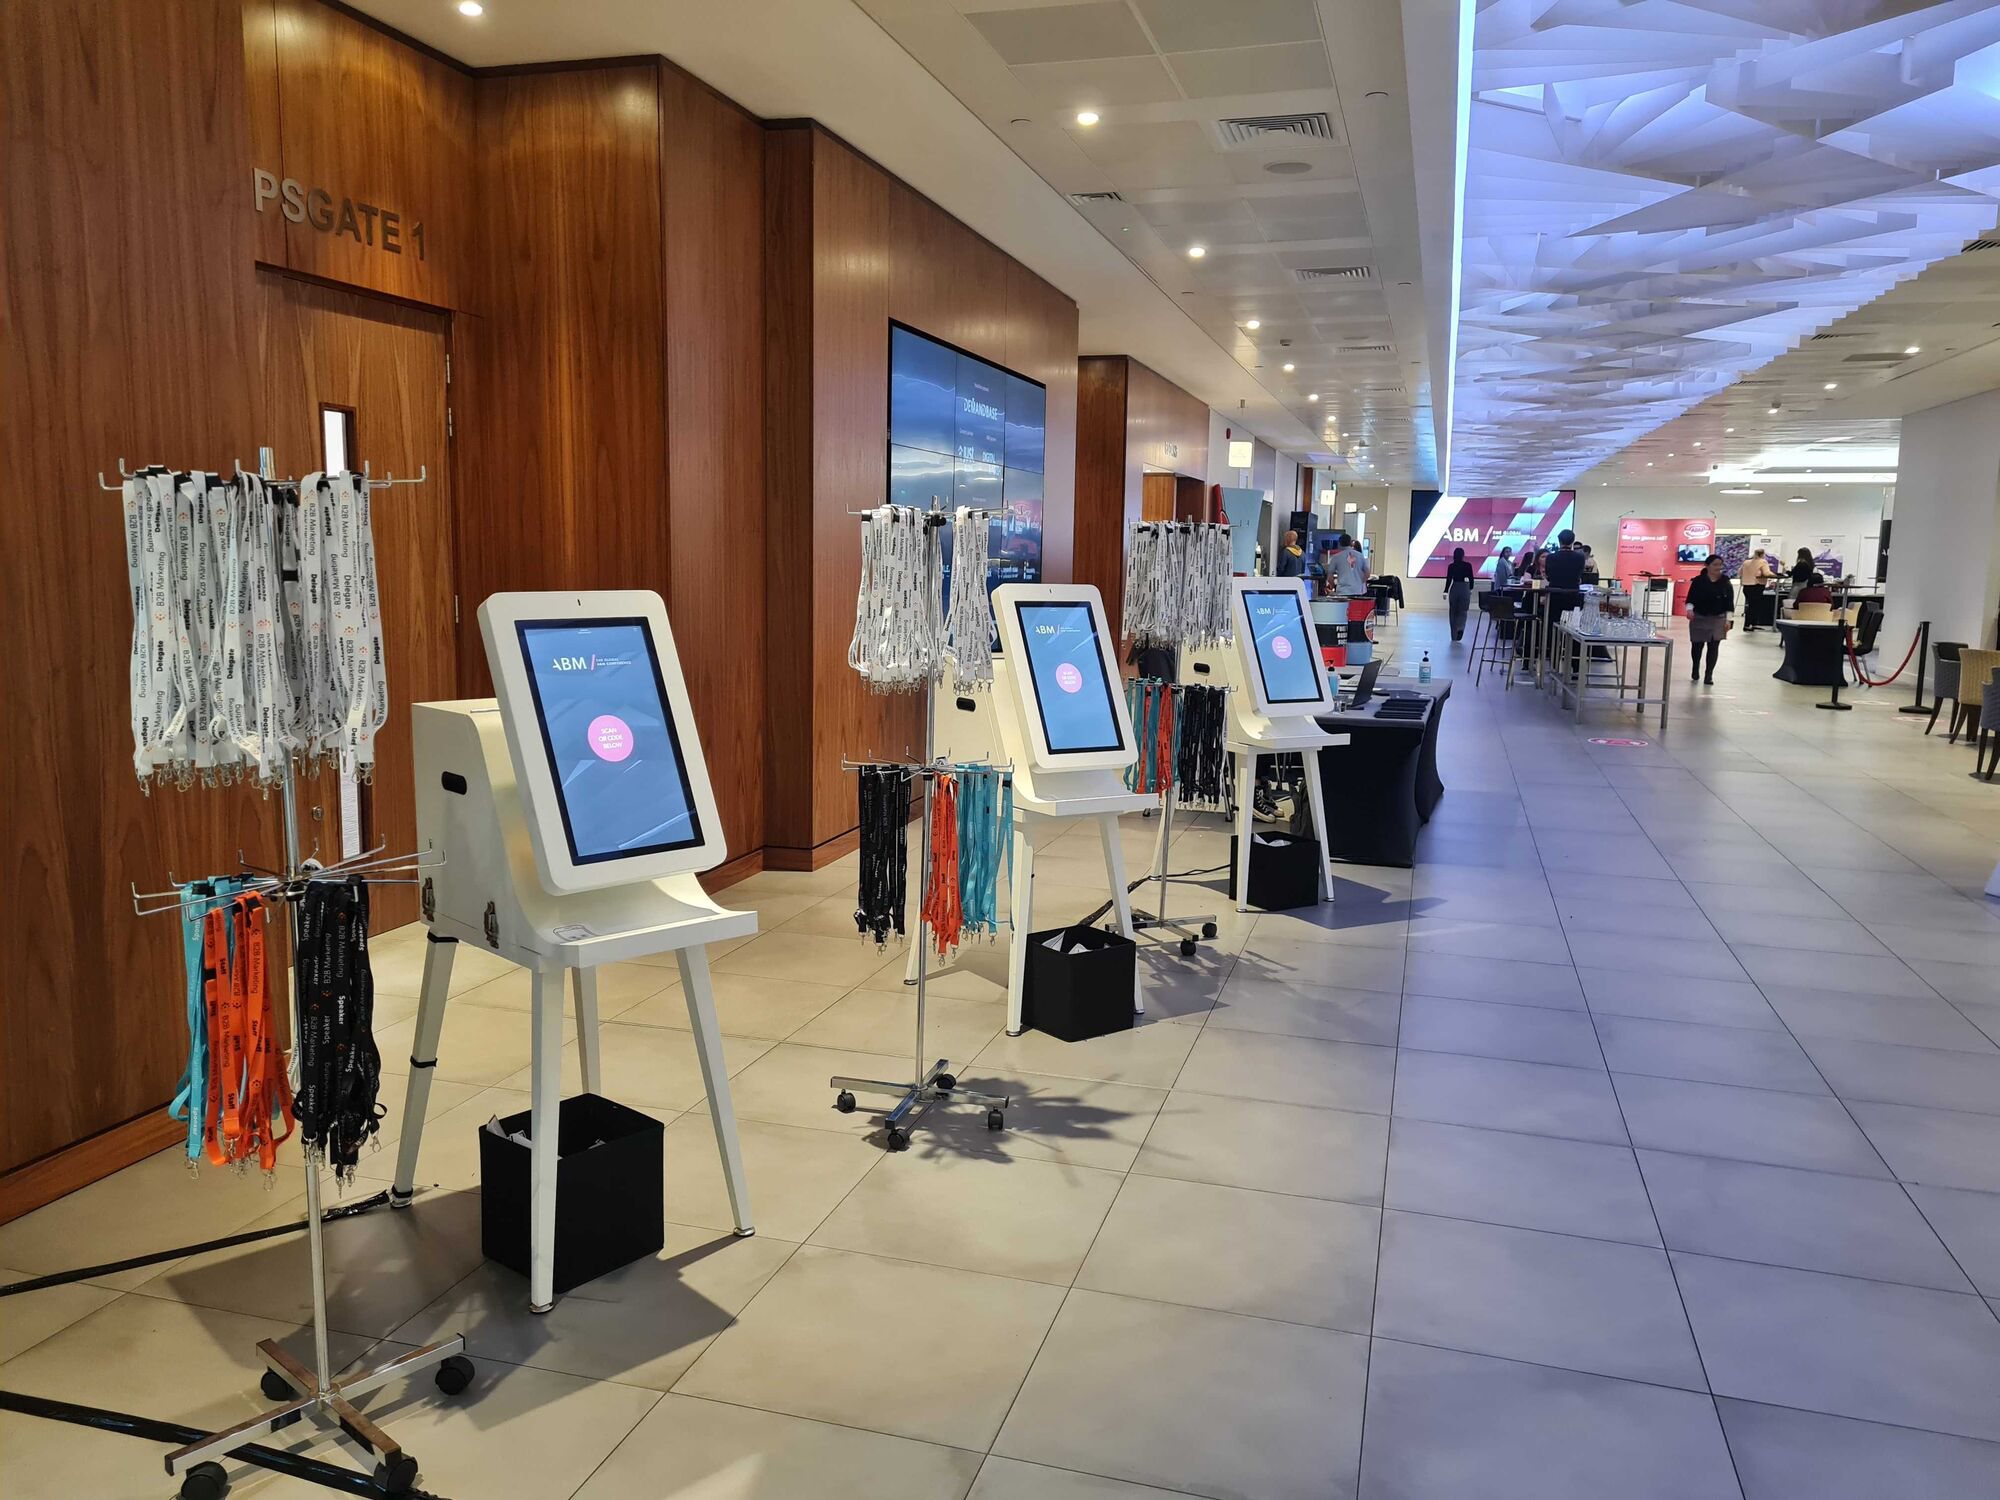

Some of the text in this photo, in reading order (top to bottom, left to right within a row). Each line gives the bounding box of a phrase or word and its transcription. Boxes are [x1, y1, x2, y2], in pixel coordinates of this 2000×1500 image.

[410, 221, 425, 261] 1
[308, 519, 316, 556] Marketing
[324, 506, 332, 536] Delegate
[340, 504, 350, 558] B2B Marketing
[1443, 528, 1479, 542] ABM
[129, 514, 138, 568] B2B Marketing
[179, 526, 189, 581] B2B Marketing
[156, 551, 166, 607] B2B Marketing
[239, 560, 248, 598] Marketing
[310, 573, 318, 604] Delegate
[330, 553, 340, 590] Marketing
[344, 574, 352, 610] Delegate
[258, 633, 266, 648] B2B
[1036, 625, 1056, 634] ABM
[139, 660, 148, 699] Marketing
[227, 648, 236, 680] Delegate
[346, 656, 355, 692] Marketing
[552, 656, 588, 671] ABM
[184, 666, 196, 704] Marketing
[356, 660, 366, 712] B2B Marketing
[376, 680, 385, 718] Marketing
[301, 913, 311, 942] Speaker
[323, 932, 332, 984] B2B Marketing
[336, 926, 346, 978] B2B Marketing
[251, 955, 261, 994] Marketing
[338, 995, 346, 1026] Speaker
[310, 1032, 318, 1068] Marketing
[345, 1043, 356, 1074] Speaker
[227, 1092, 235, 1110] Staff
[308, 1084, 316, 1114] Speaker
